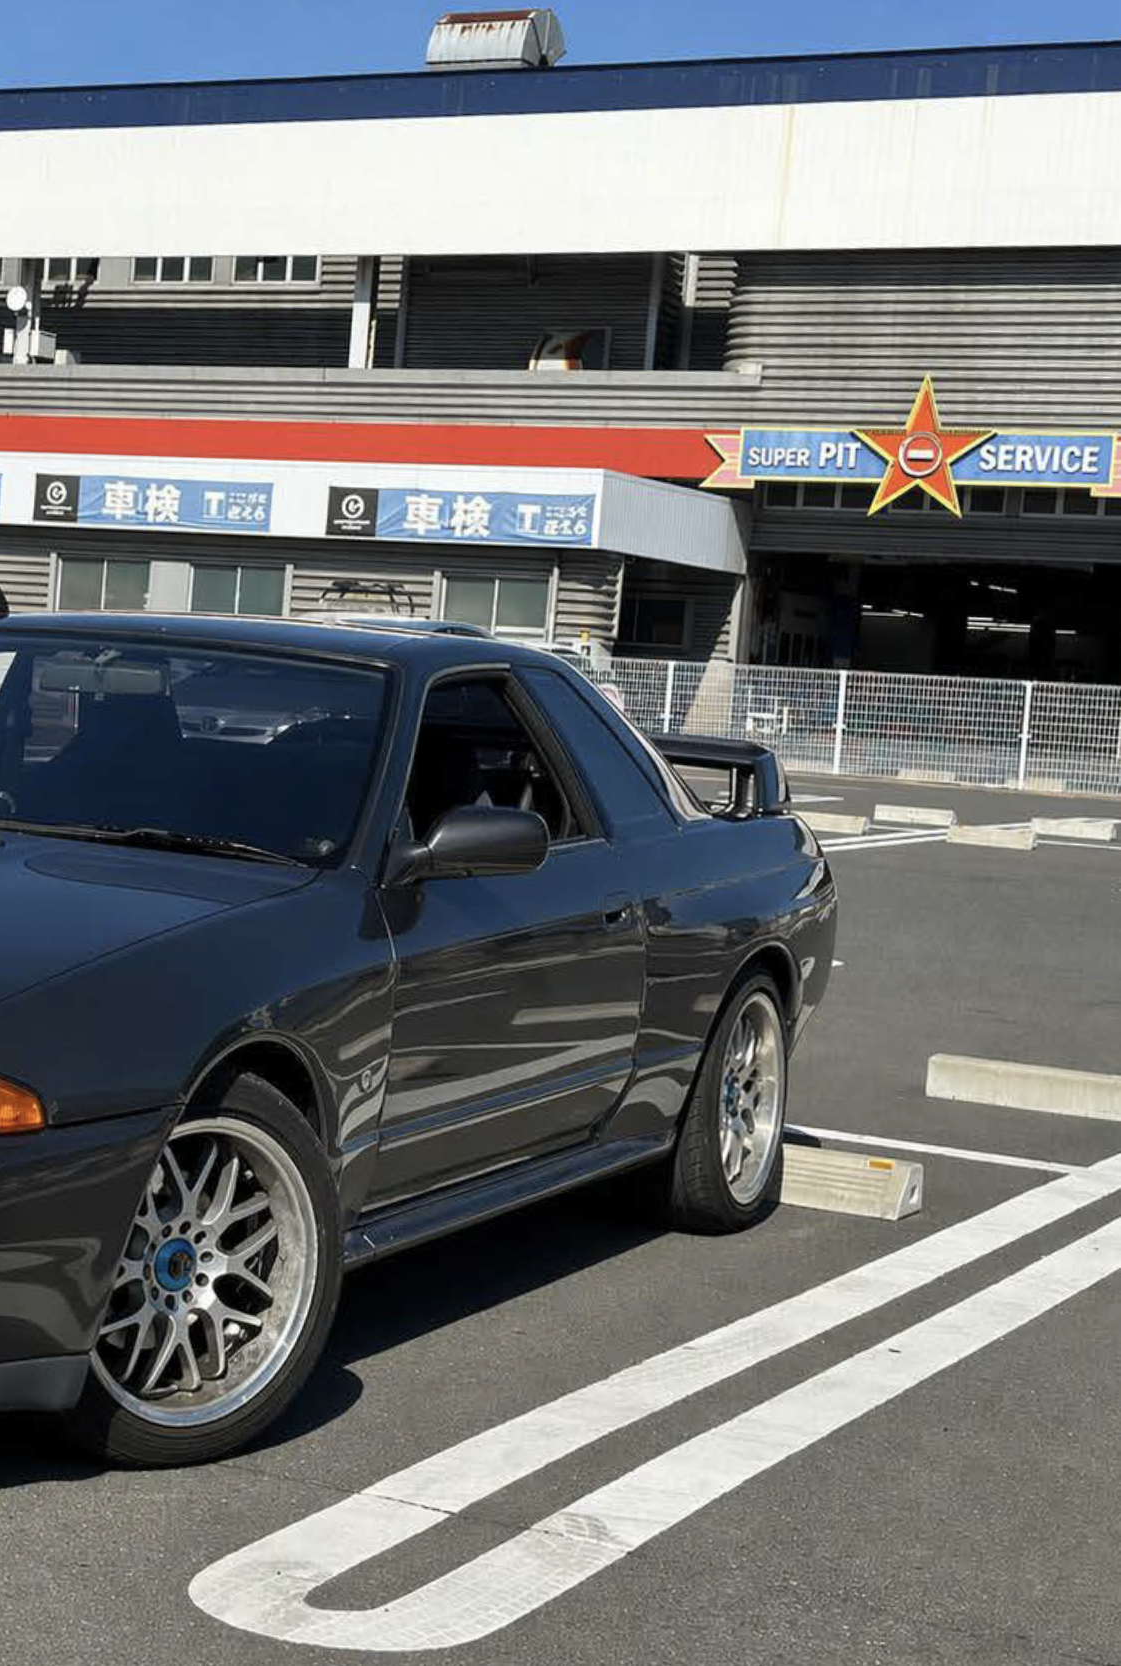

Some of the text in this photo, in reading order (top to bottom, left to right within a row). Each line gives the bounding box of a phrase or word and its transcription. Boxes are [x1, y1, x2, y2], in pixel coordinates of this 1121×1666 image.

[748, 441, 1101, 473] SUPER PIT SERVICE
[102, 480, 181, 522] 車検
[402, 493, 493, 537] 車検
